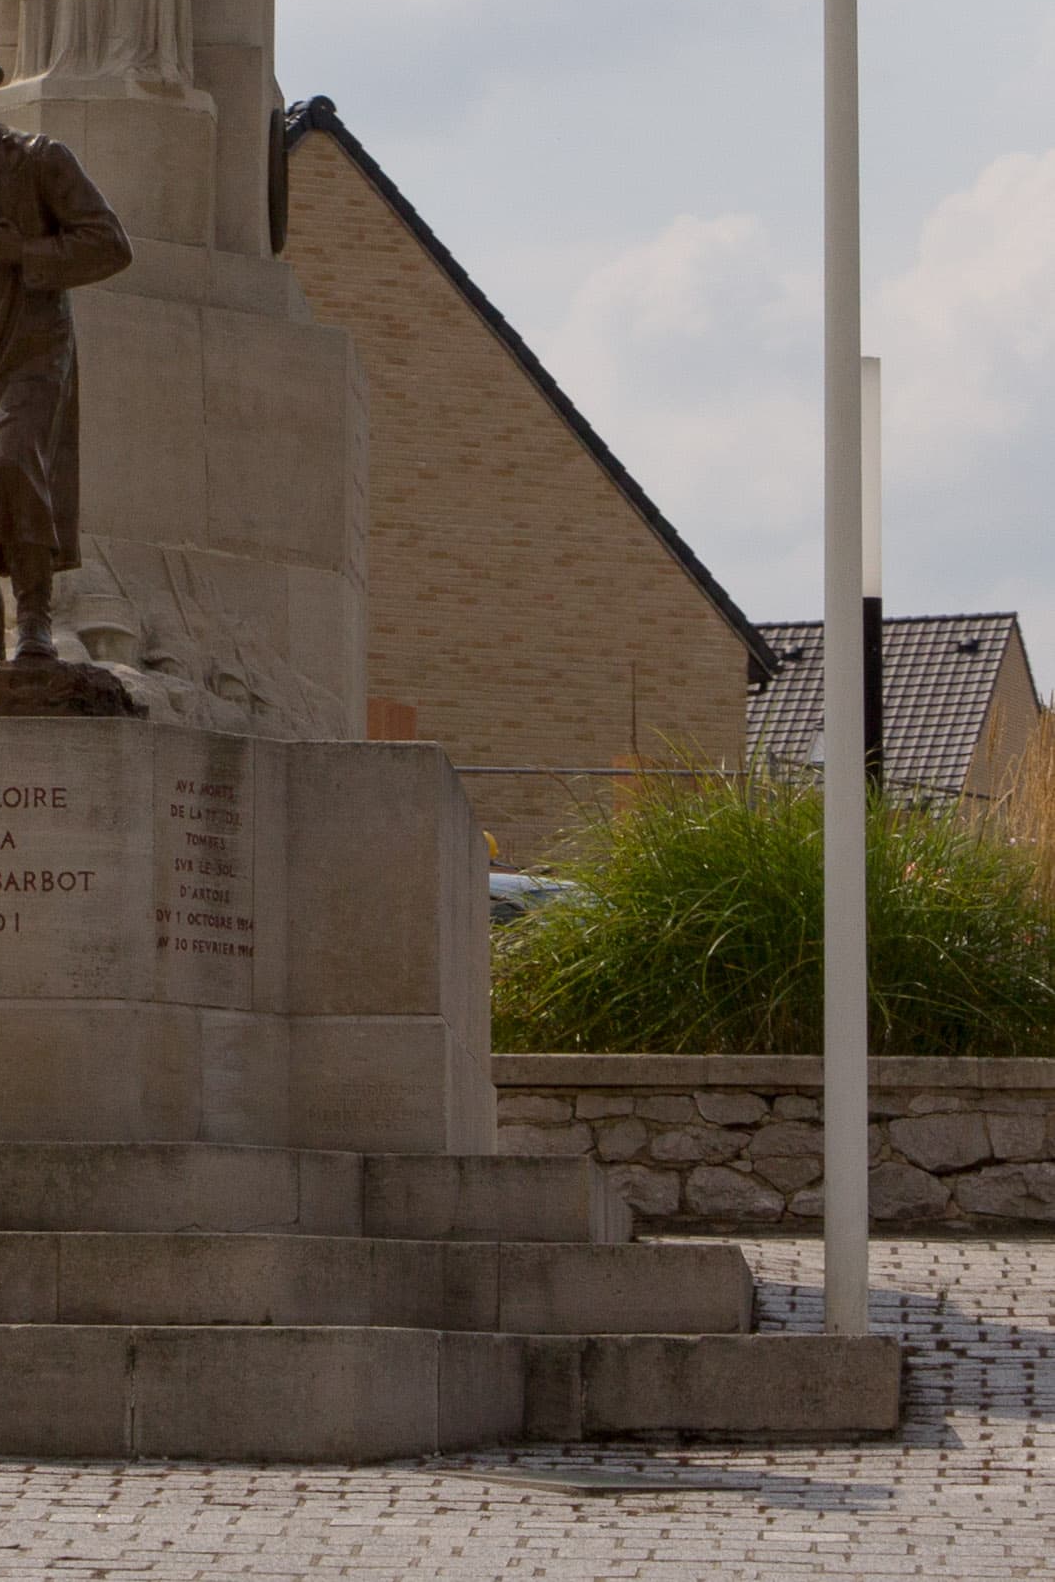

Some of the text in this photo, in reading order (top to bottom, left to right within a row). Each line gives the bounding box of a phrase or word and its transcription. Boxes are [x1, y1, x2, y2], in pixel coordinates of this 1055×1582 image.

[170, 803, 185, 819] DE
[189, 805, 202, 820] LA
[155, 908, 171, 923] DV
[187, 913, 233, 930] OCTOBRE
